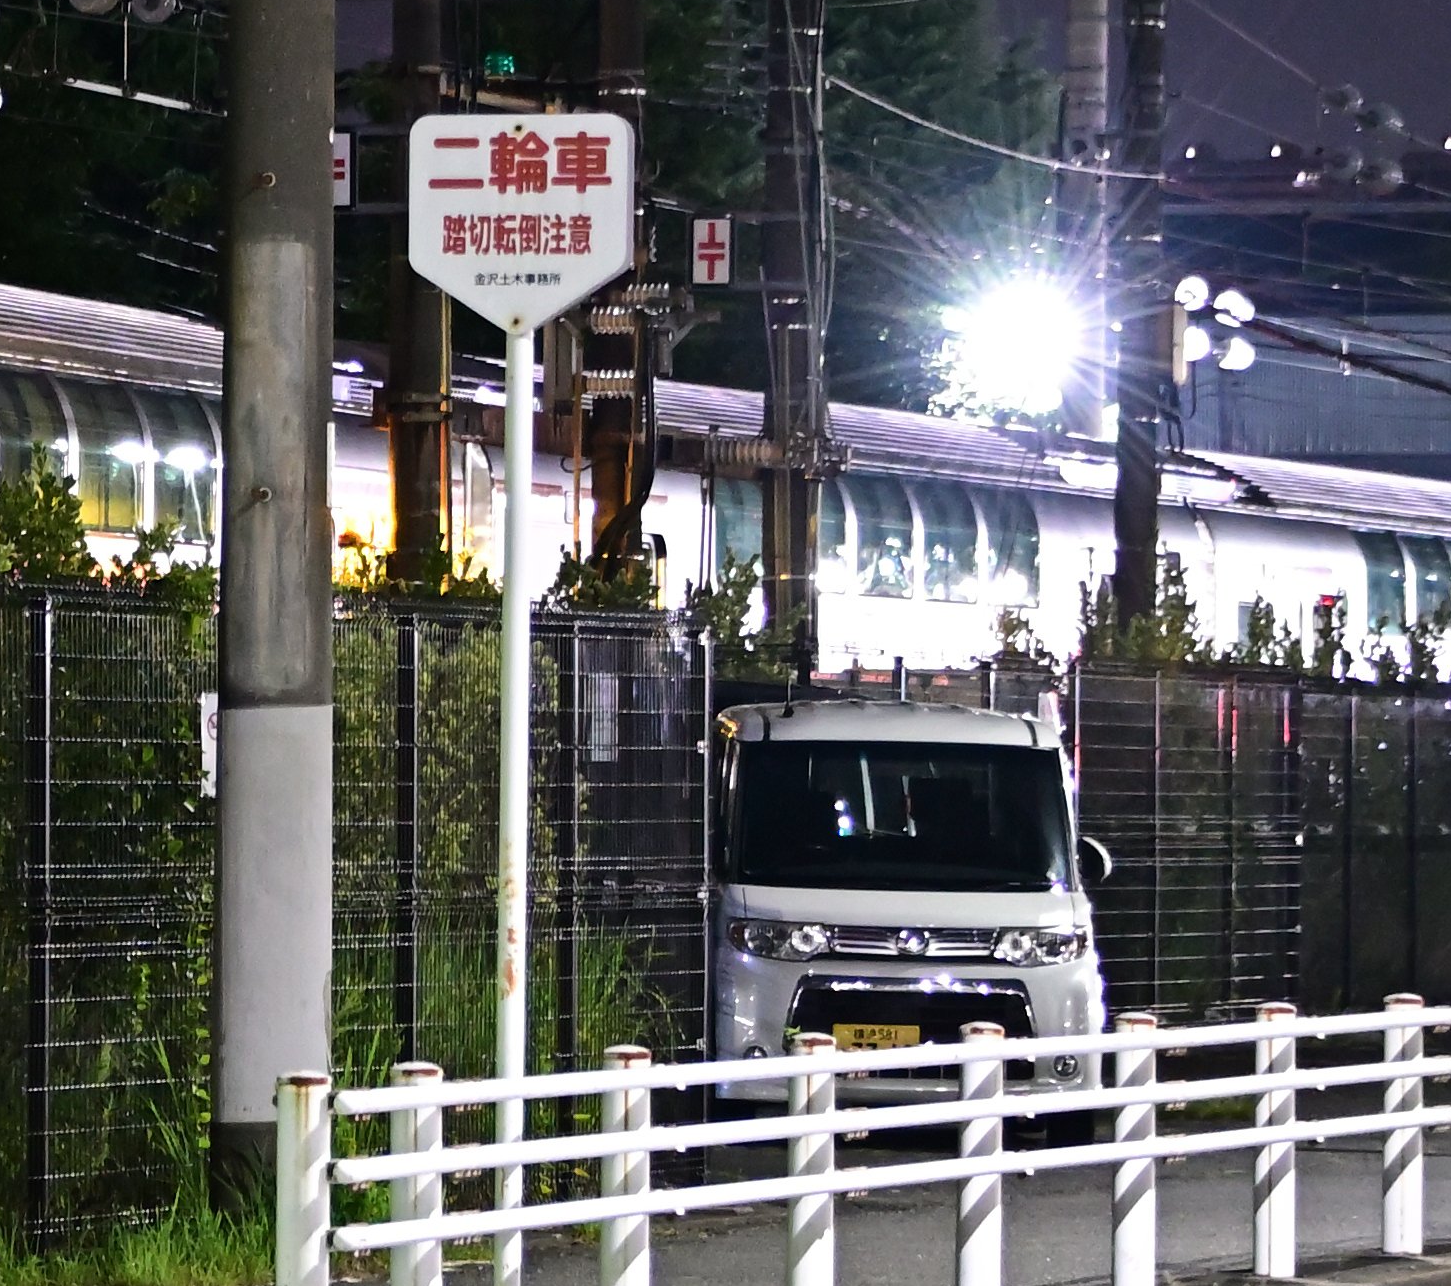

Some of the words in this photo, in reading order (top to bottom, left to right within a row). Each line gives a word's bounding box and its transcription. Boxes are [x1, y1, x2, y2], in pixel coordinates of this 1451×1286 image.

[428, 131, 613, 194] 二輪車
[442, 214, 592, 256] 踏切転倒注意
[474, 272, 561, 287] 金沢土木事務所
